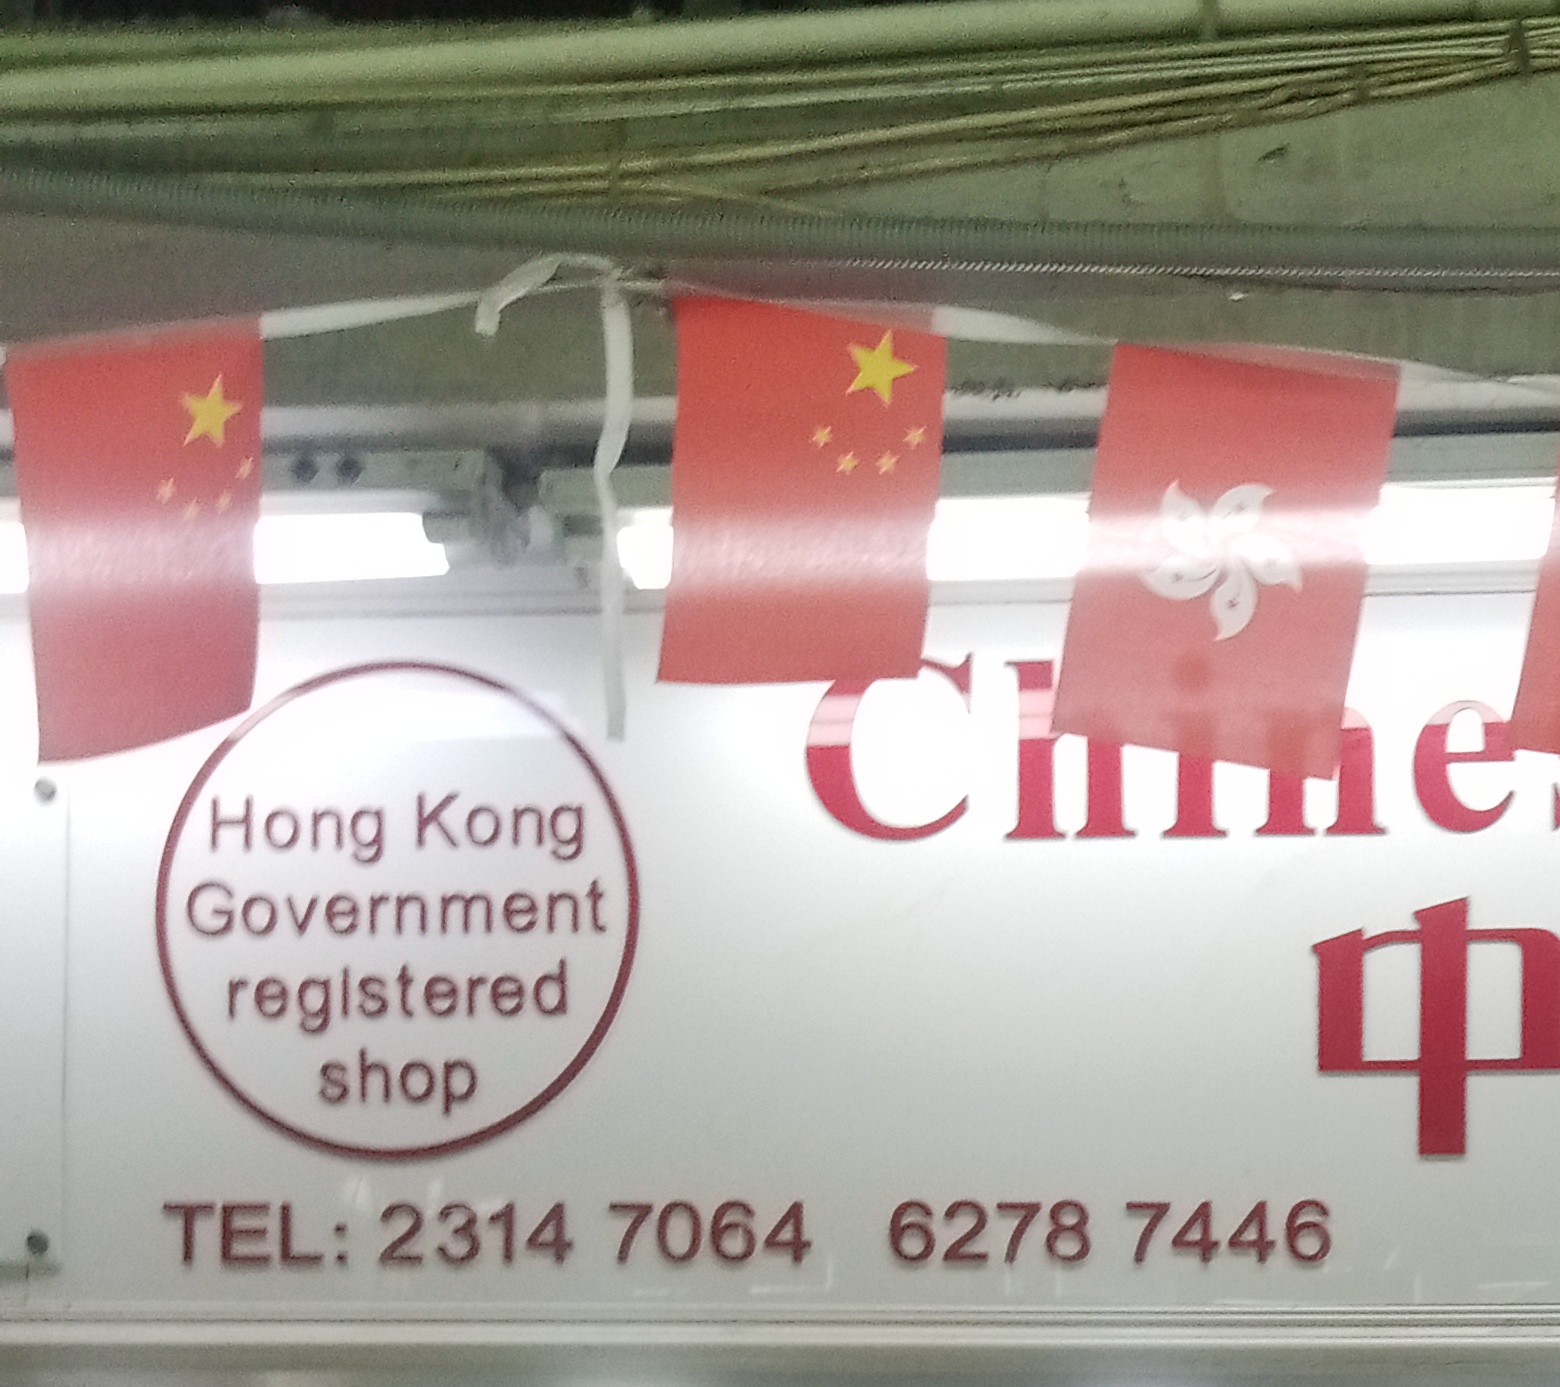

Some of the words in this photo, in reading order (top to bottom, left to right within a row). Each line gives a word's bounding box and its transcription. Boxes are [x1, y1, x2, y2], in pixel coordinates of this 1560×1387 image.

[209, 795, 384, 863] Hong
[412, 792, 587, 861] Kong
[185, 879, 608, 938] Government
[226, 959, 569, 1035] registered
[318, 1048, 479, 1116] shop
[161, 1200, 350, 1267] TEL:
[377, 1200, 575, 1265] 2314
[609, 1199, 814, 1263] 7064
[887, 1198, 1092, 1265] 6278
[1125, 1198, 1334, 1265] 7446
